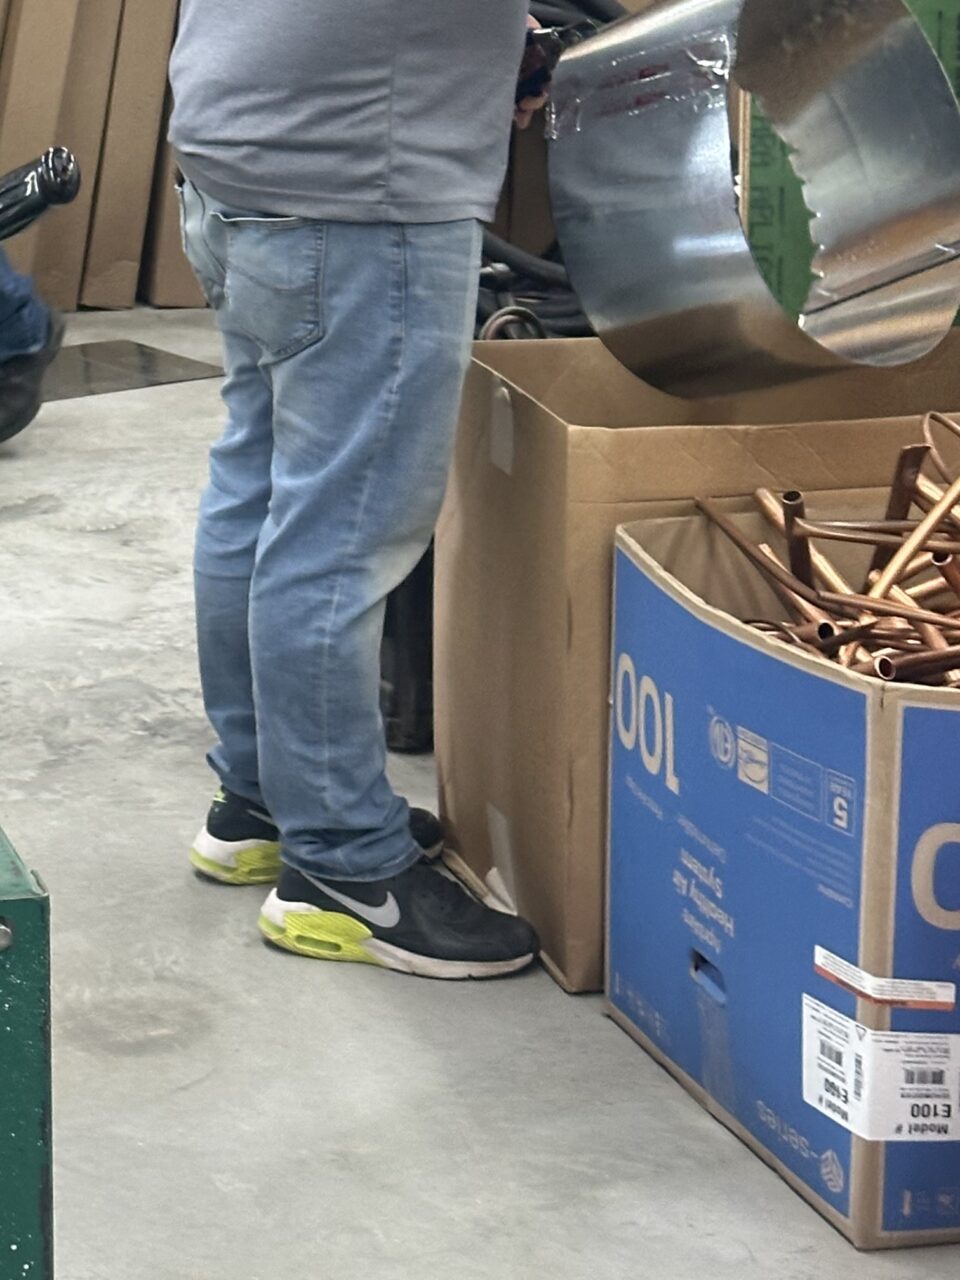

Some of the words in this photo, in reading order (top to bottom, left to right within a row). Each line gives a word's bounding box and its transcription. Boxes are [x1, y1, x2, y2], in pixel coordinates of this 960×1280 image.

[616, 652, 680, 796] 100
[832, 795, 849, 829] 5
[911, 1103, 952, 1119] E100
[907, 1123, 949, 1135] Model
